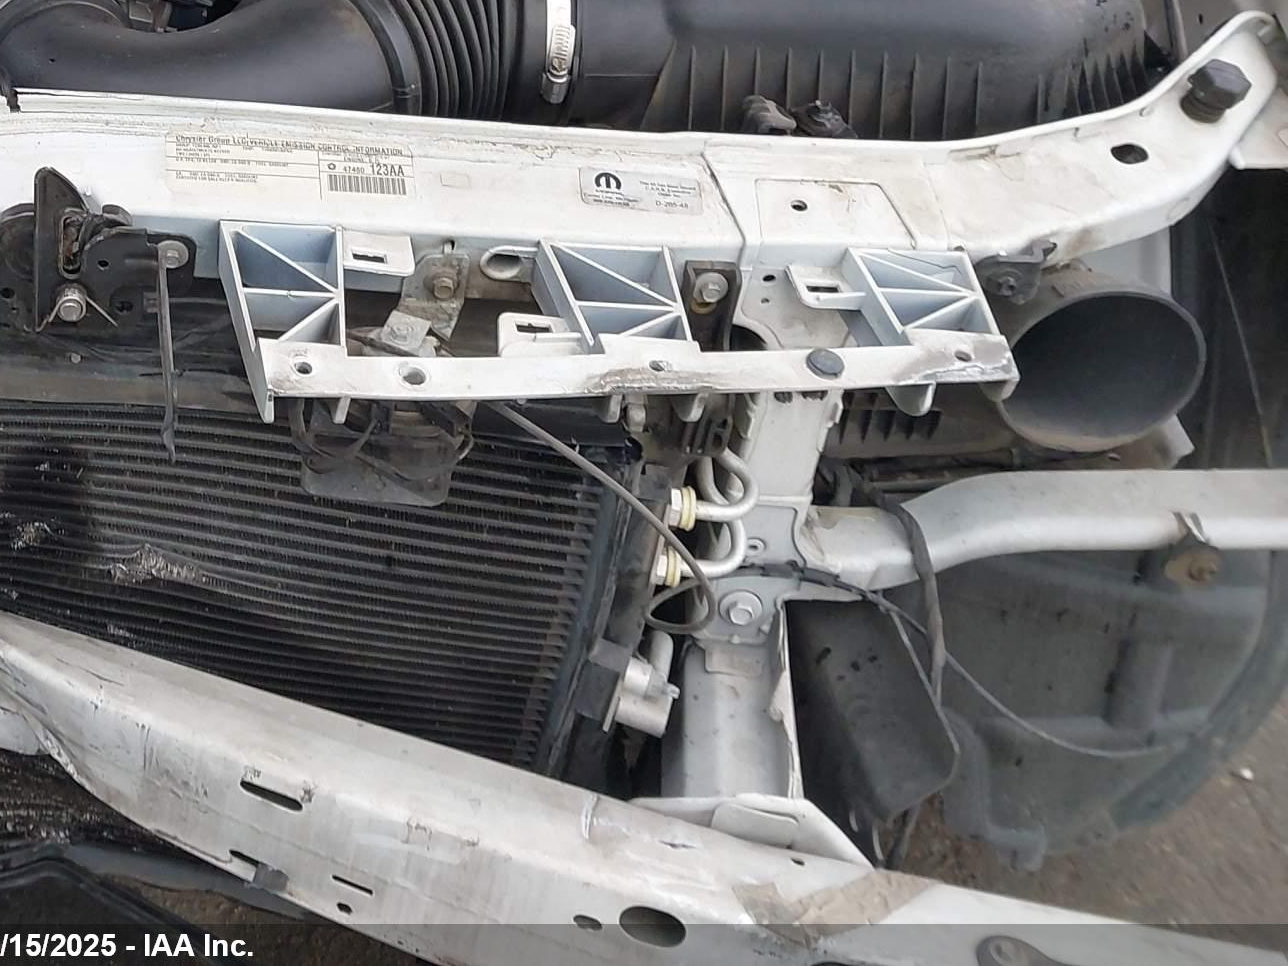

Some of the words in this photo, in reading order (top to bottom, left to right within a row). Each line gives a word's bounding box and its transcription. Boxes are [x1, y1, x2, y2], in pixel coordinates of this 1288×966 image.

[175, 135, 207, 144] Chrysler
[208, 136, 231, 146] Group
[318, 143, 350, 153] CONTROL
[352, 145, 403, 156] INFORMATION
[371, 163, 405, 177] 123AA
